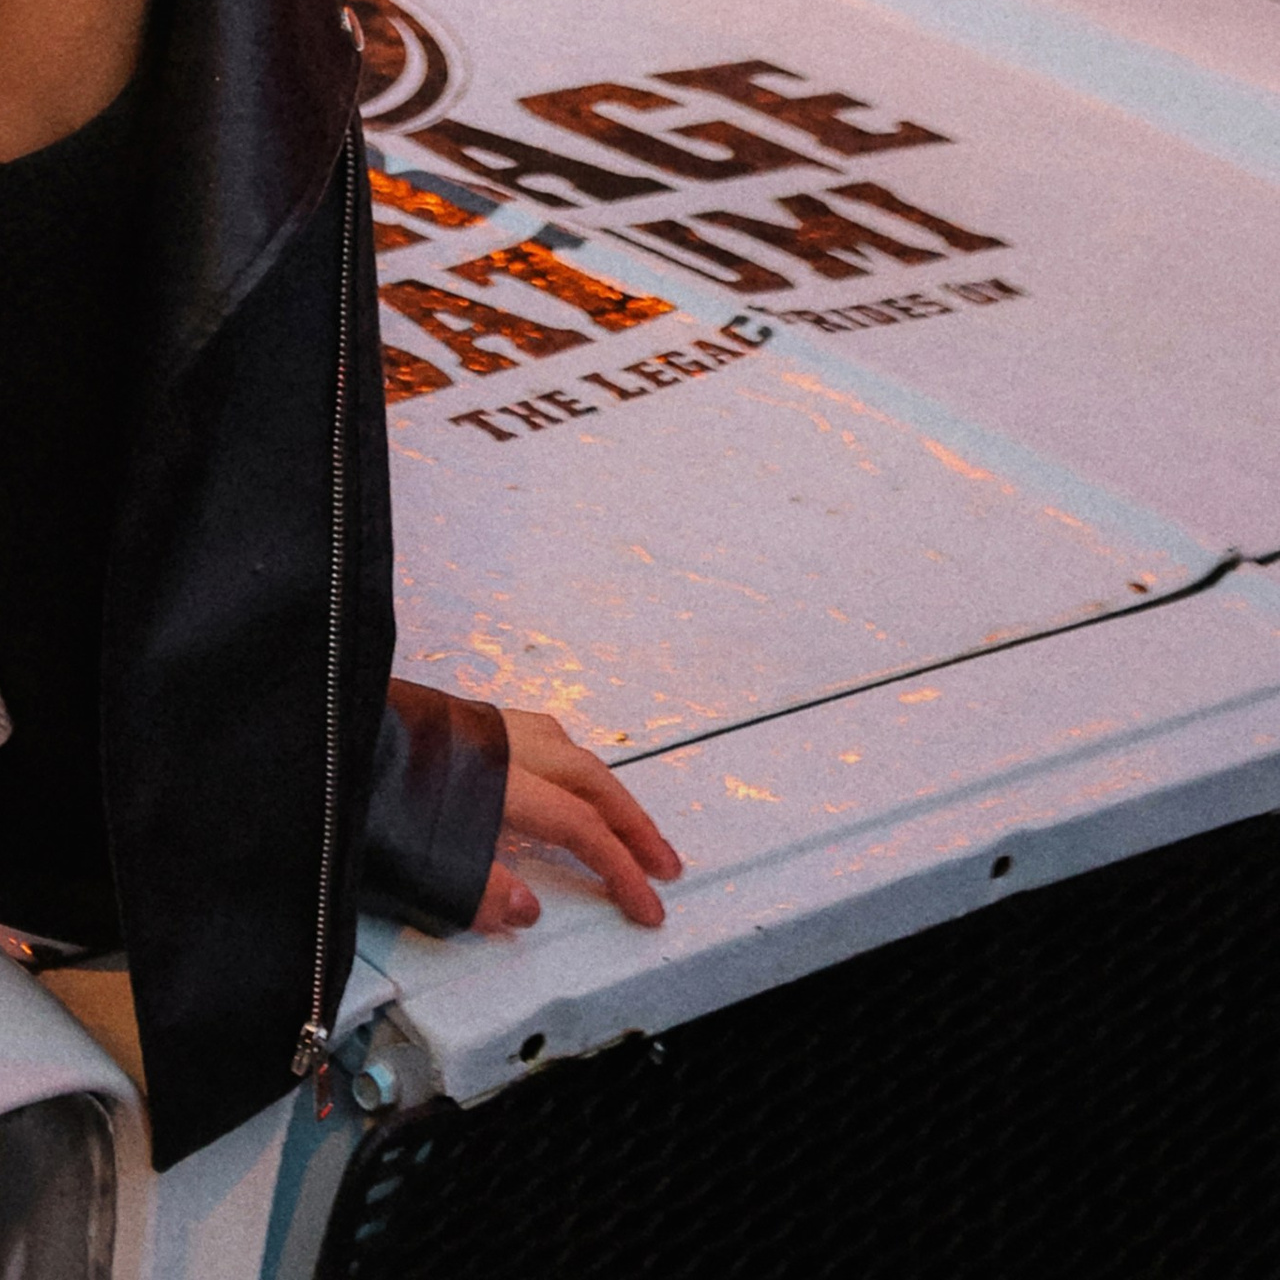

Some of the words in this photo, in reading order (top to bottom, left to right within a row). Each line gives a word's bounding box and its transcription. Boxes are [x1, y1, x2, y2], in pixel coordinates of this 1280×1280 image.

[380, 181, 1012, 407] ATUMI
[448, 390, 600, 442] THE
[786, 291, 954, 332] RIDES
